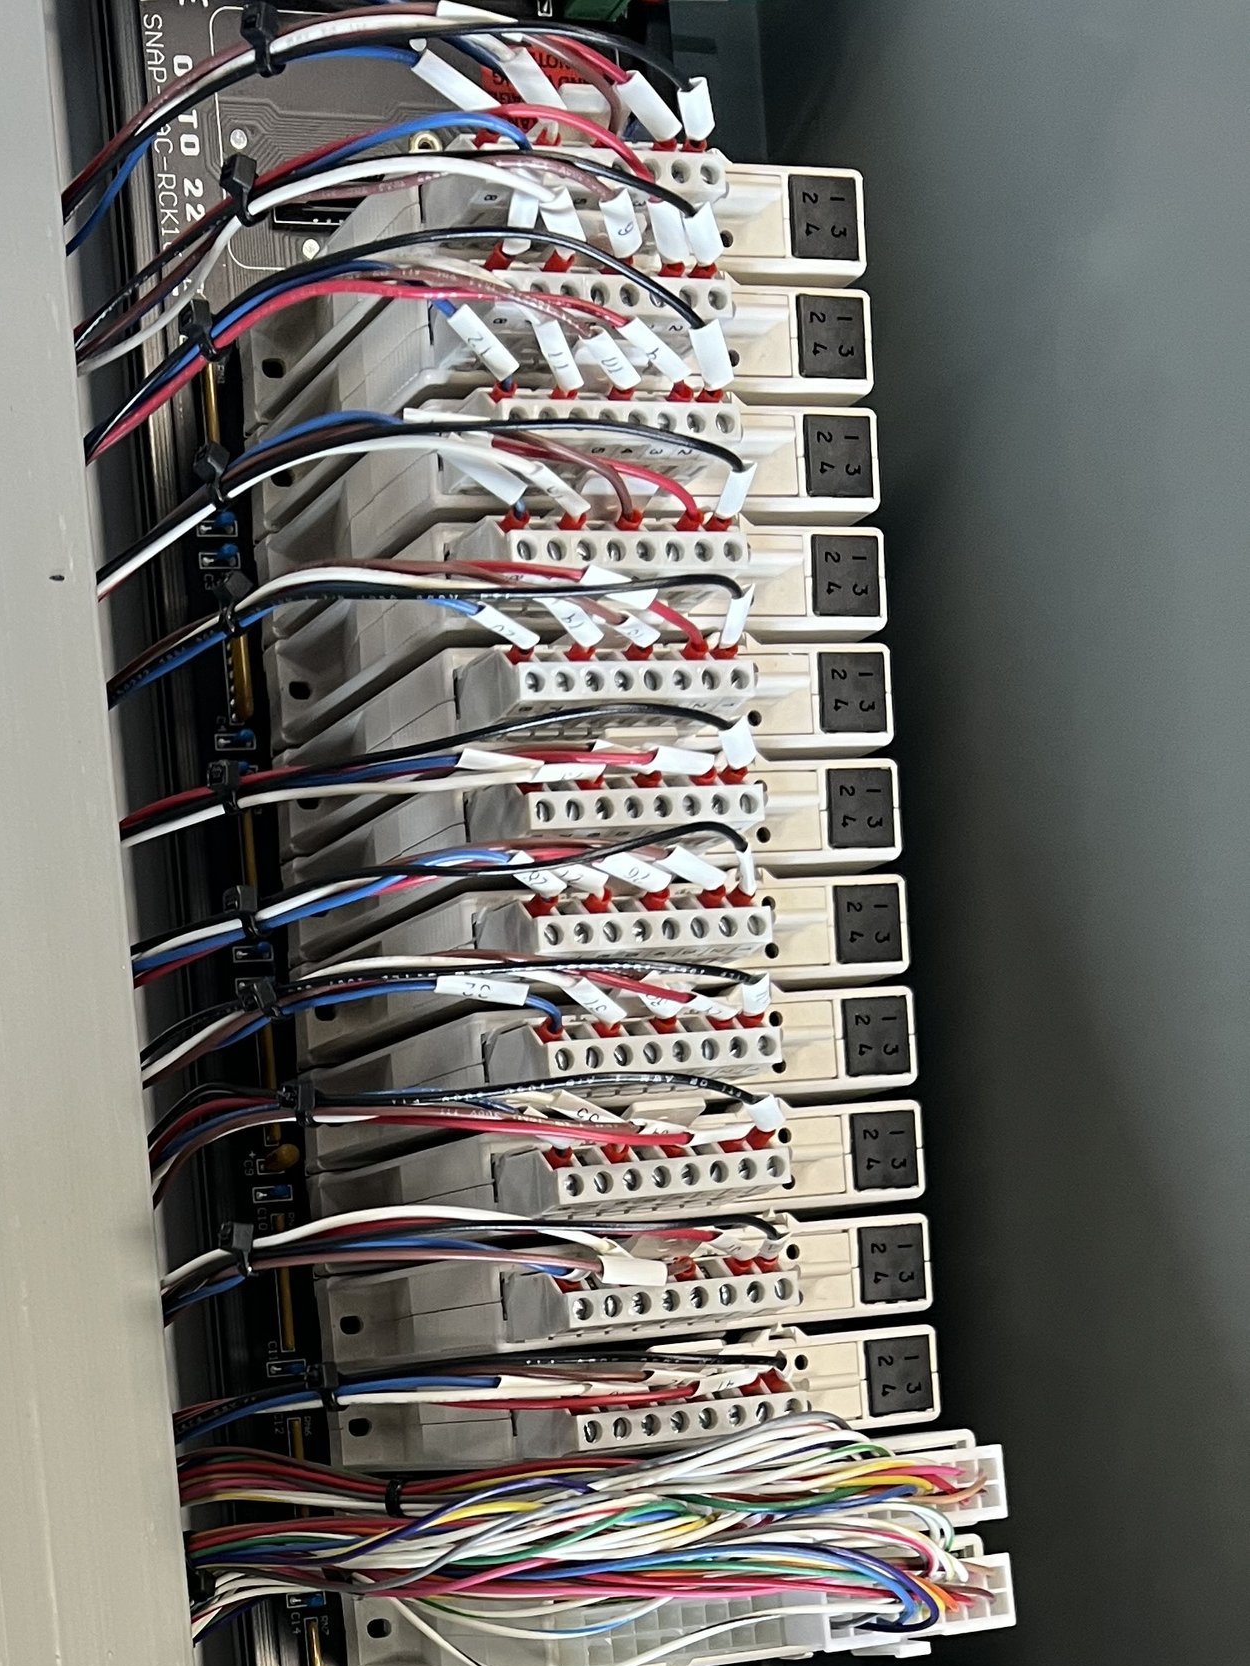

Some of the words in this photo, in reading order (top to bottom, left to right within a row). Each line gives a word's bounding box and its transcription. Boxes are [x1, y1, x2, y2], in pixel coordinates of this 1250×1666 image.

[173, 54, 200, 156] OTO
[183, 178, 205, 222] 22
[802, 192, 818, 204] 2
[805, 223, 820, 236] 4
[831, 225, 847, 238] 3
[810, 312, 826, 323] 2
[812, 342, 827, 356] 4
[839, 345, 854, 357] 3
[817, 431, 832, 442] 2
[820, 462, 835, 474] 4
[846, 464, 861, 475] 3
[825, 552, 840, 563] 2
[827, 582, 841, 595] 4
[853, 584, 868, 596] 3
[831, 669, 847, 680] 2
[834, 699, 848, 711] 4
[859, 700, 875, 712] 3
[840, 785, 855, 796] 2
[842, 815, 856, 827] 4
[867, 816, 883, 828] 3
[847, 902, 862, 912] 2
[849, 931, 864, 943] 4
[875, 932, 890, 943] 3
[855, 1015, 871, 1025] 2
[859, 1044, 873, 1056] 4
[883, 1044, 899, 1055] 3
[863, 1129, 879, 1140] 2
[866, 1158, 881, 1170] 4
[891, 1158, 907, 1169] 3
[871, 1243, 887, 1253] 2
[874, 1272, 889, 1284] 4
[899, 1272, 914, 1282] 3
[878, 1355, 893, 1366] 2
[882, 1384, 896, 1397] 4
[907, 1382, 922, 1394] 3
[291, 1612, 300, 1634] C14
